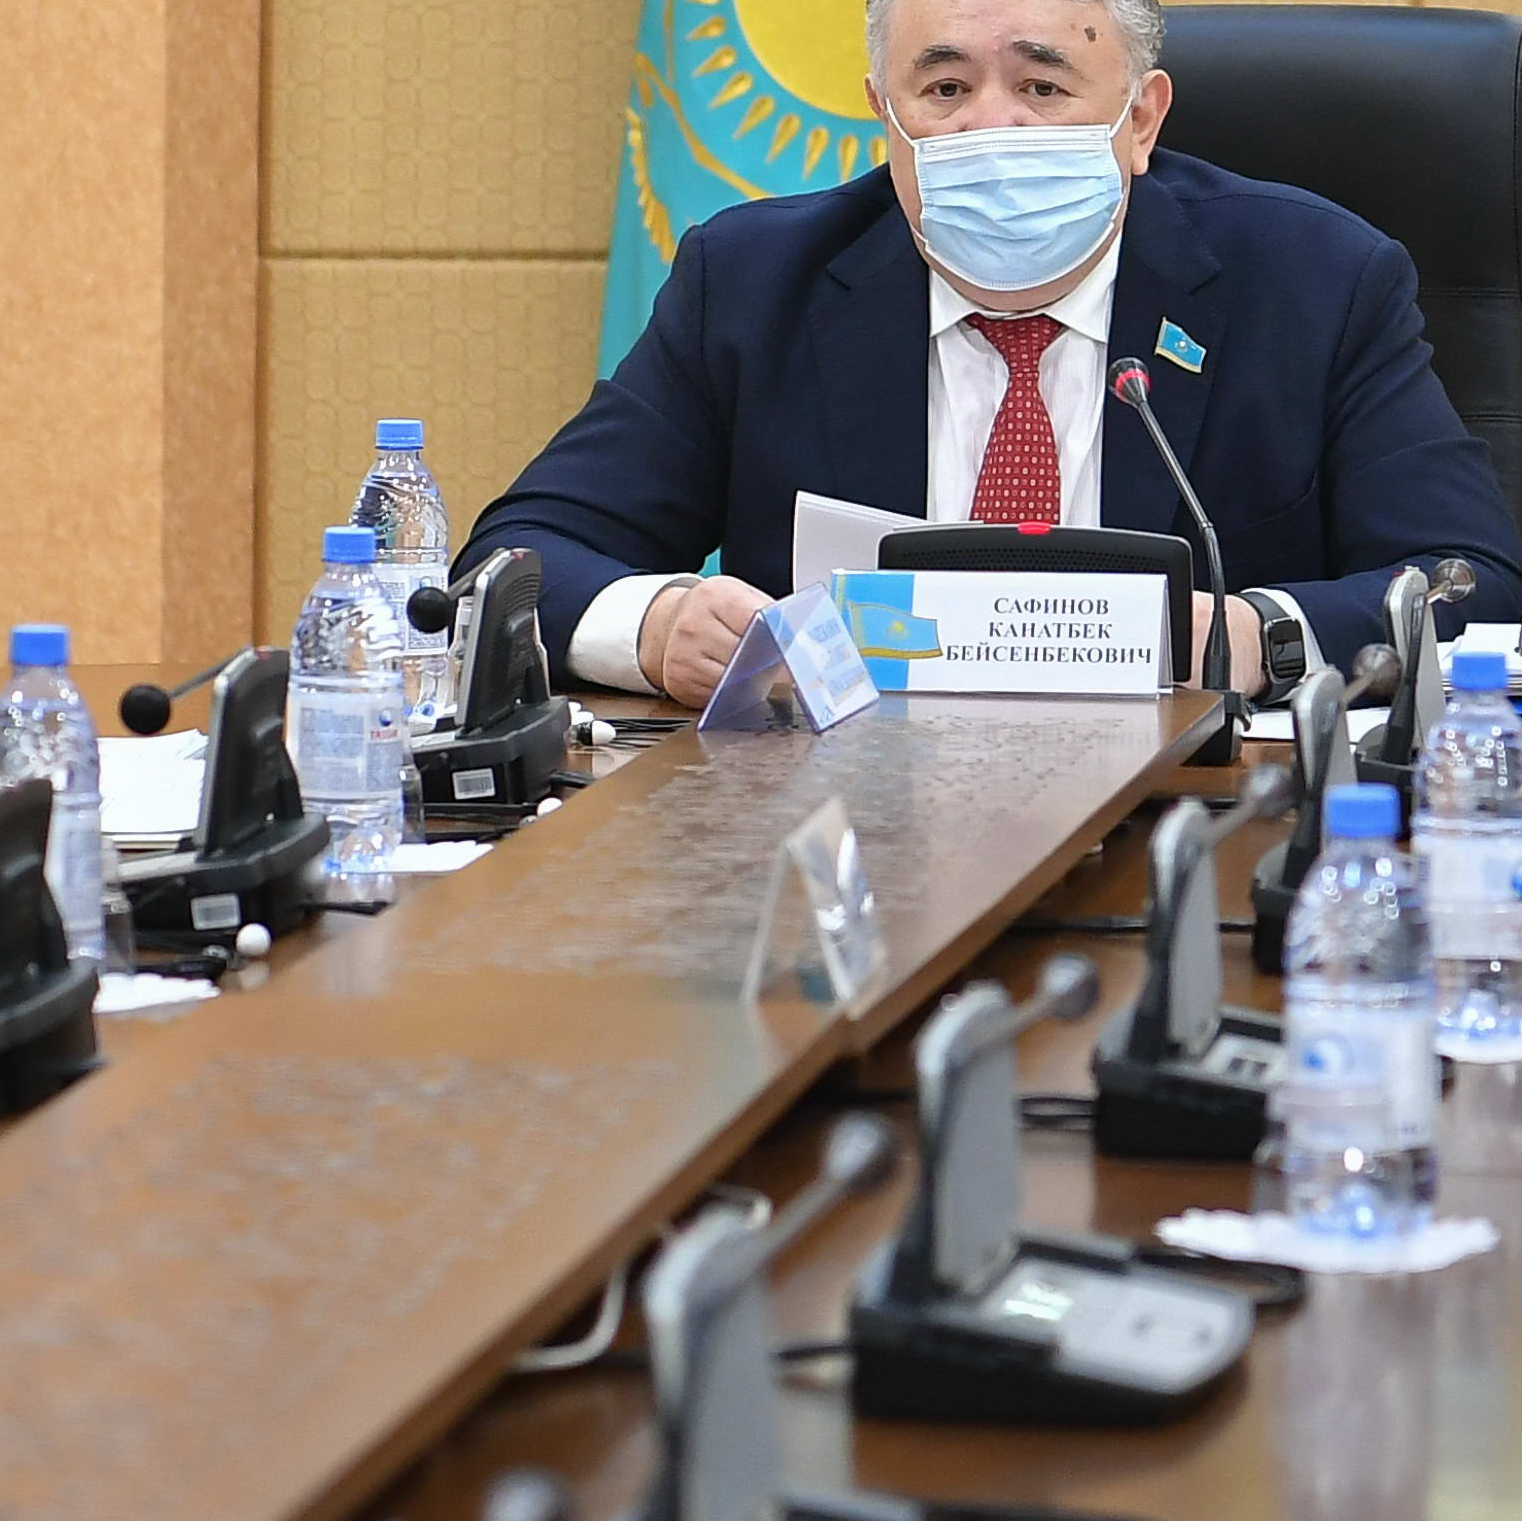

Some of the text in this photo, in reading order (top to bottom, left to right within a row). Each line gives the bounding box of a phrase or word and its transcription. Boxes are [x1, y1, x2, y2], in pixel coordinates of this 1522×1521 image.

[994, 597, 1109, 615] САФИНОВ
[988, 621, 1113, 639] КАНАТБЕК
[946, 641, 1151, 663] БЕЙСЕНБЕКОВИЧ
